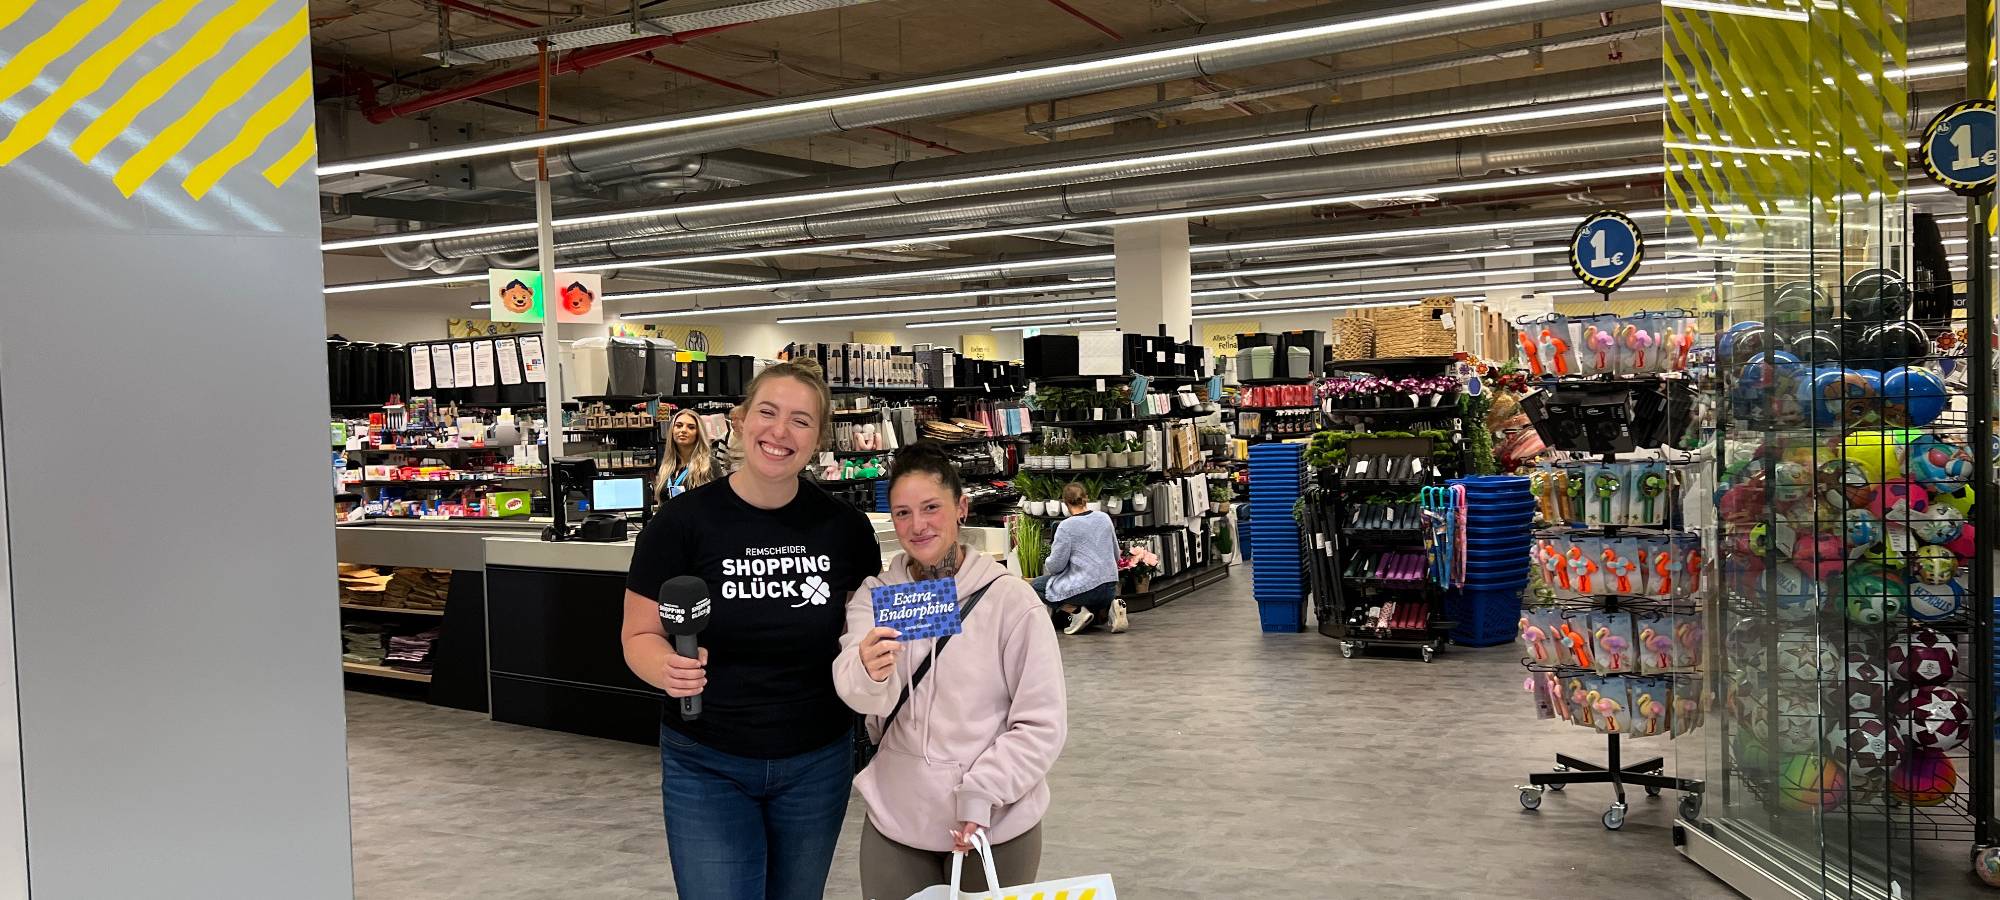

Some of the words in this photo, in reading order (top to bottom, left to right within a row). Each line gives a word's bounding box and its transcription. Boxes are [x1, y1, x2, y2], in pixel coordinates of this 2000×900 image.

[1937, 122, 1949, 132] Ab
[745, 545, 807, 556] REMSCHEIDER
[721, 554, 831, 576] SHOPPING
[721, 577, 799, 599] GLÜCK
[892, 591, 937, 606] Extra-
[878, 601, 955, 622] Endorphine
